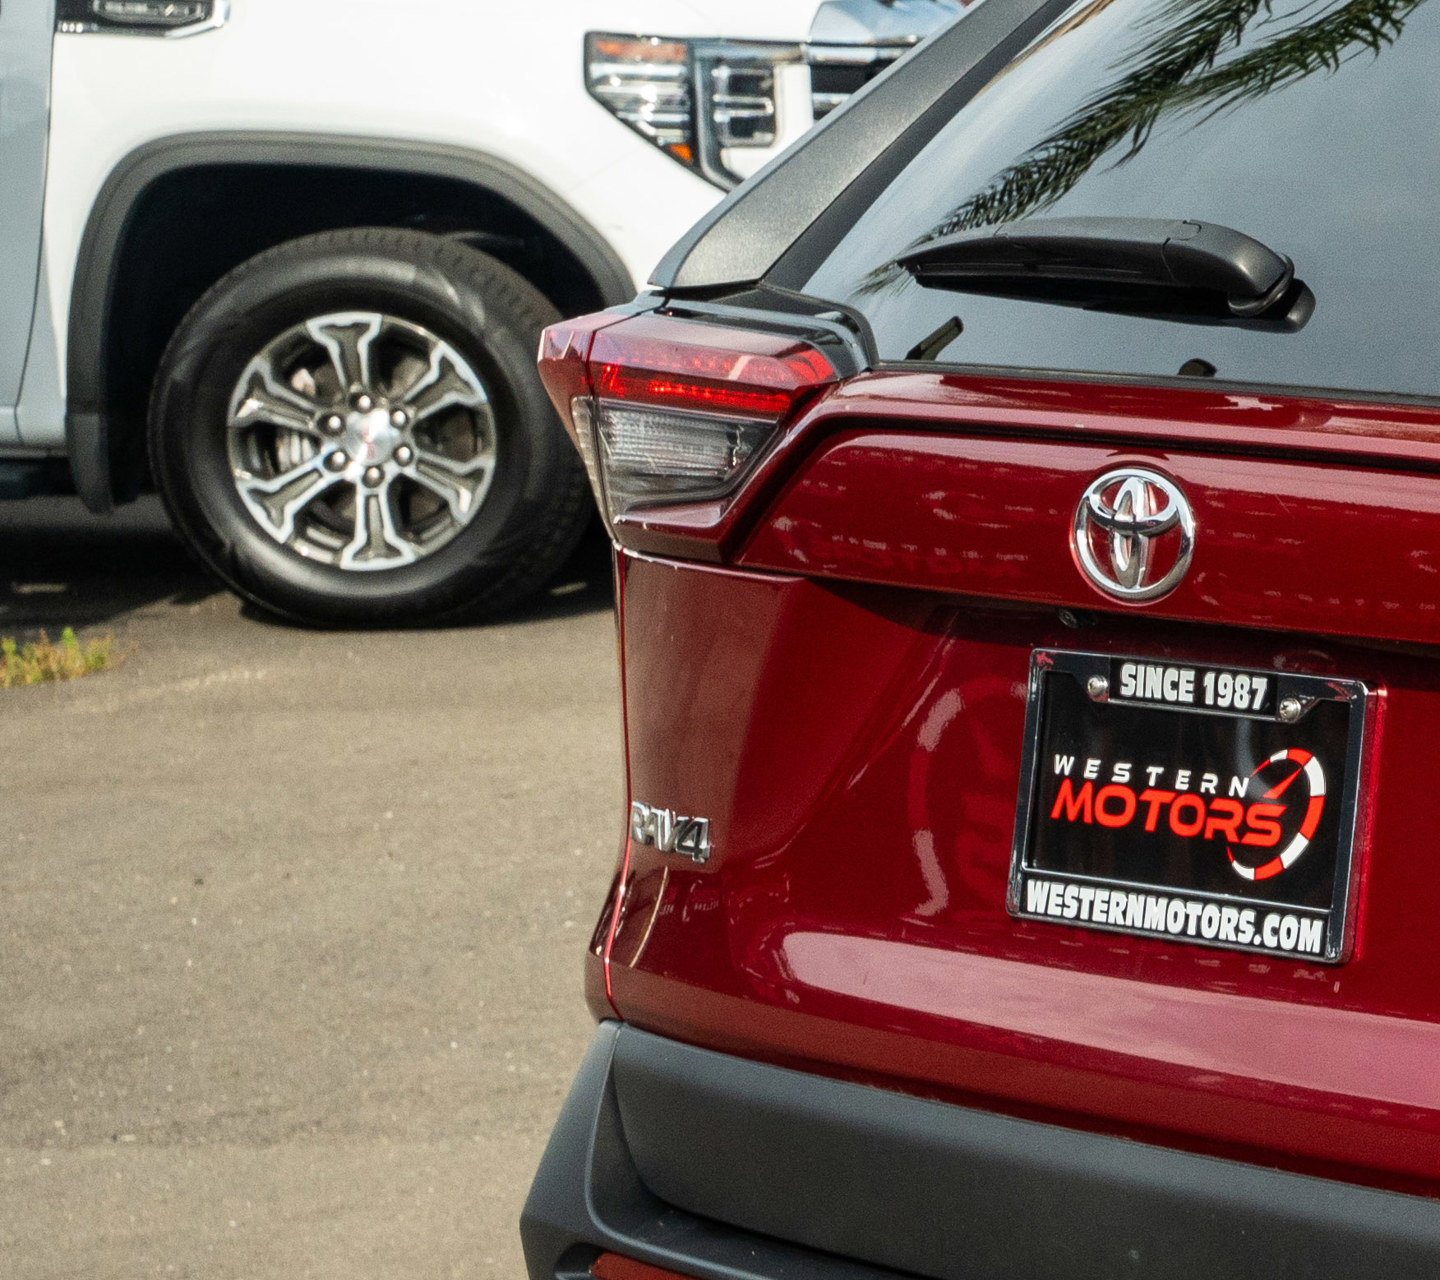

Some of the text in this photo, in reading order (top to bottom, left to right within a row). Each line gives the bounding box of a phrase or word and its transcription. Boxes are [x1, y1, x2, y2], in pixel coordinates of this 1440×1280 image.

[1120, 663, 1268, 710] SINCE 1987
[1053, 753, 1251, 798] WESTERN
[631, 800, 712, 864] RAV4
[1050, 779, 1287, 848] MOTORS
[1026, 879, 1324, 954] WESTERNMOTORS.COM
